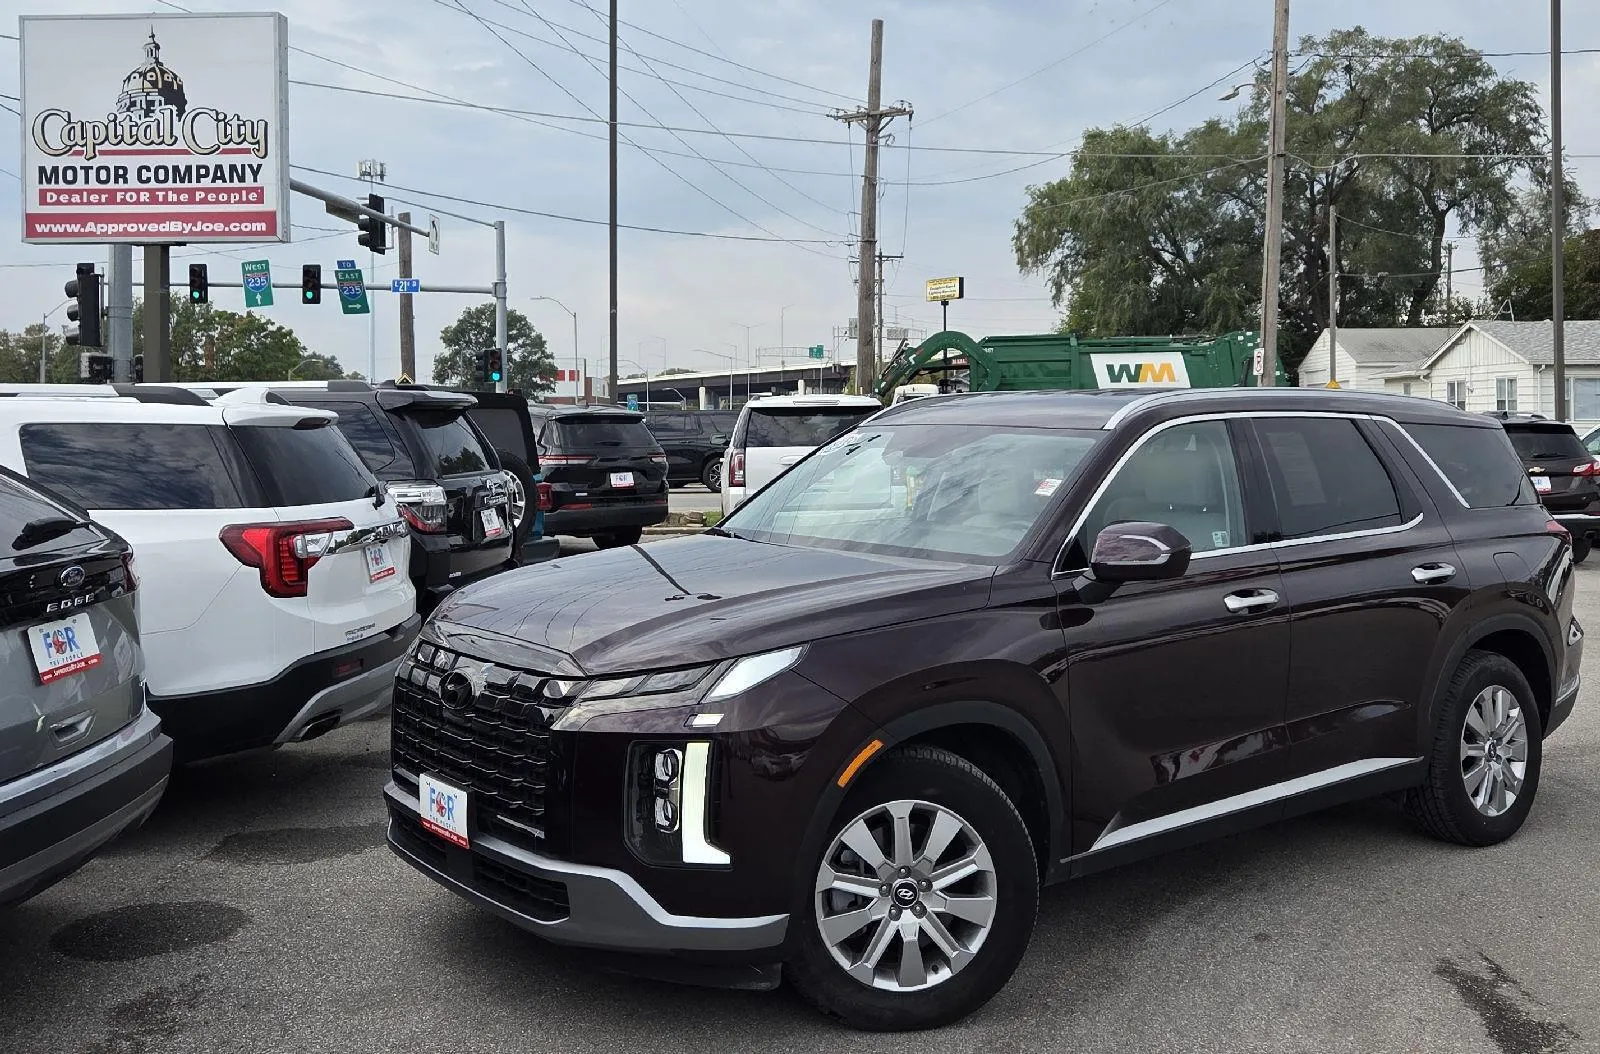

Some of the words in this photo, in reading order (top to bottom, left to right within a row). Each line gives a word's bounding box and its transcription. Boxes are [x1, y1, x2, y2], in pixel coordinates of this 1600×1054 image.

[32, 107, 178, 160] Capital
[182, 107, 268, 159] City
[38, 165, 129, 185] MOTOR
[136, 163, 263, 184] COMPANY
[46, 191, 108, 203] Dealer
[116, 191, 150, 203] FOR
[155, 190, 189, 203] The
[195, 190, 258, 204] People
[35, 220, 267, 234] www.ApprovedByJoe.com
[248, 276, 267, 287] 235
[342, 285, 361, 295] 235
[1106, 363, 1176, 384] WM
[46, 592, 95, 613] EDGE
[42, 626, 80, 659] FOR
[429, 786, 456, 823] FOR
